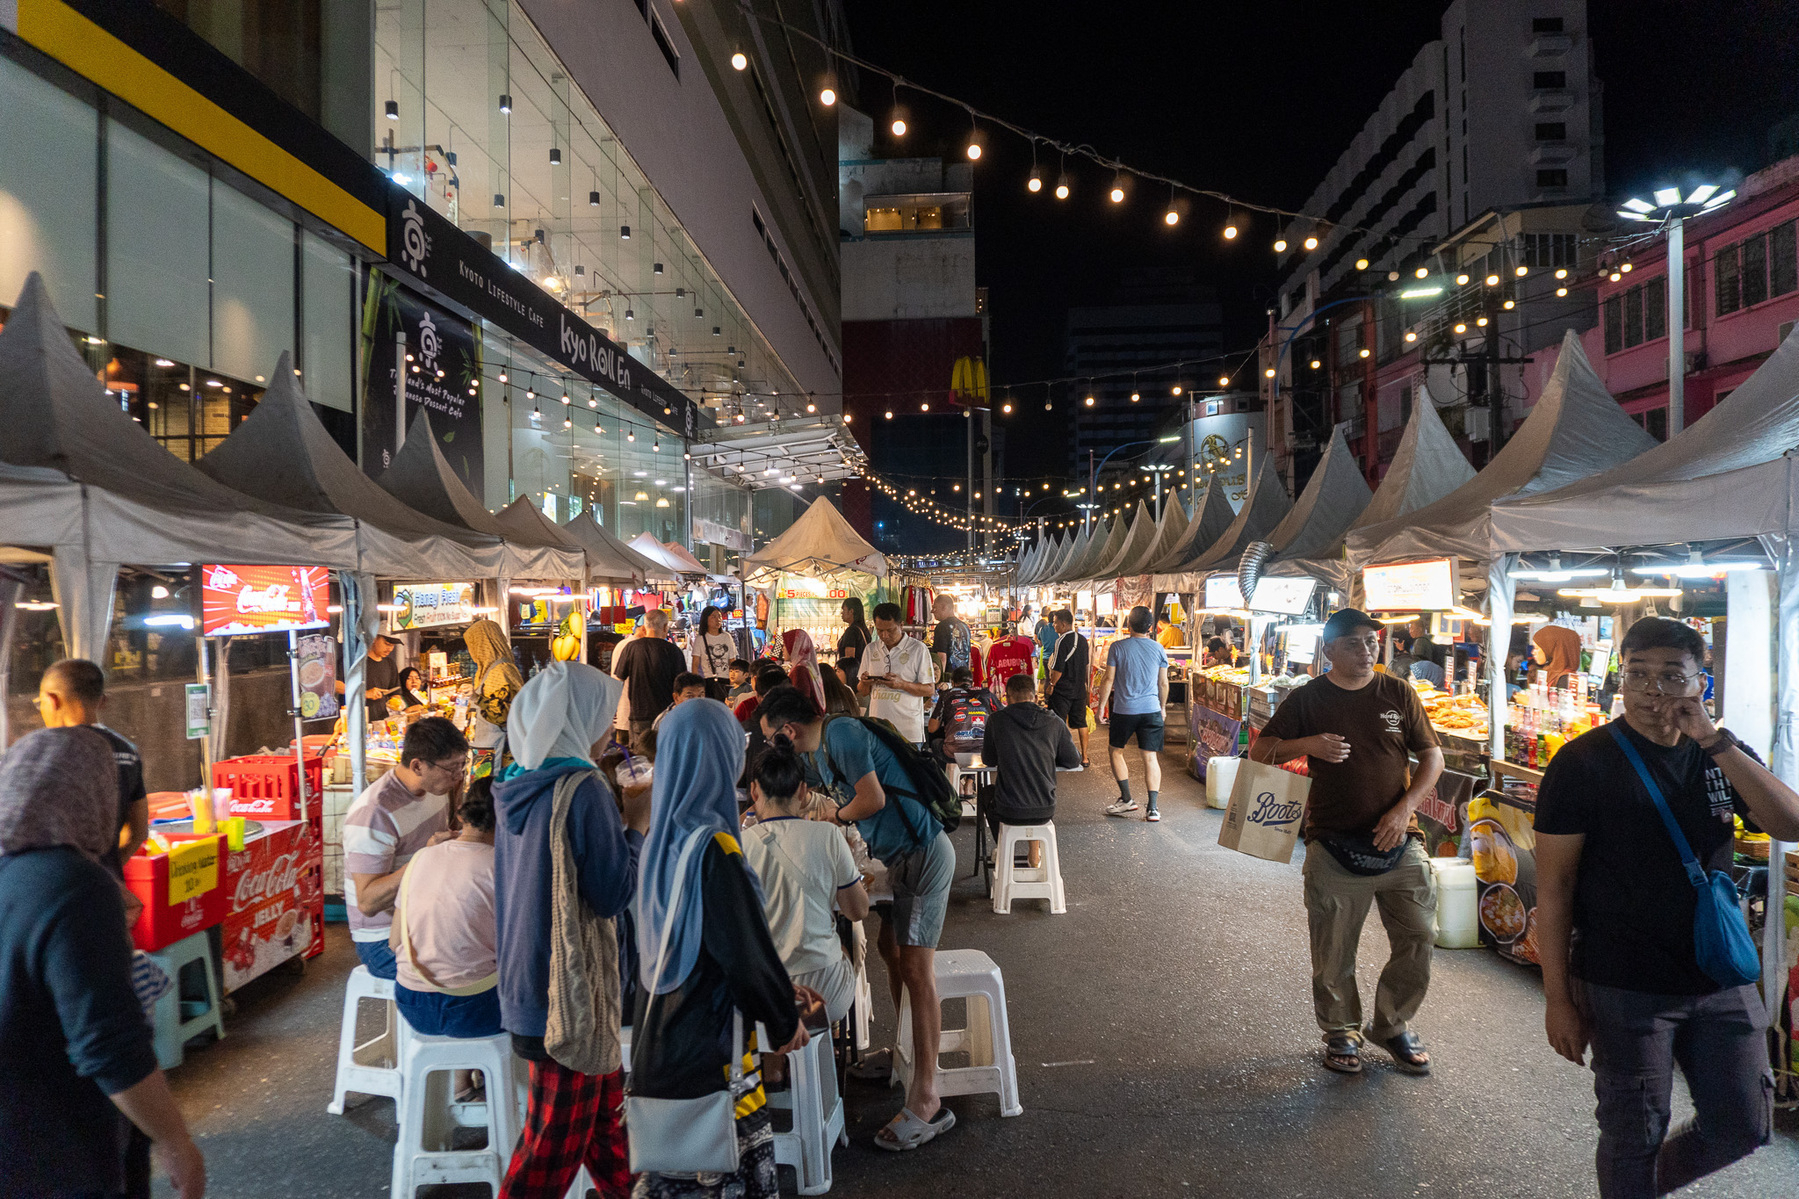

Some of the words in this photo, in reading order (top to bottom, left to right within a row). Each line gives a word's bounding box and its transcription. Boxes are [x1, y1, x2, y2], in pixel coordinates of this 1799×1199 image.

[459, 259, 484, 289] KYOTO
[487, 279, 526, 317] LIFESTYLE
[528, 307, 544, 328] CAFE
[560, 313, 587, 364] kyo
[617, 356, 631, 391] En
[423, 397, 448, 412] Dessert
[448, 406, 463, 422] Cafe
[425, 385, 442, 396] Most
[442, 390, 466, 407] Popular
[787, 589, 795, 599] 5
[796, 590, 811, 598] PIECES
[1246, 791, 1303, 826] Boots
[1707, 788, 1732, 803] WIL
[233, 850, 300, 913] Coca-Cola
[253, 900, 285, 929] JELLY
